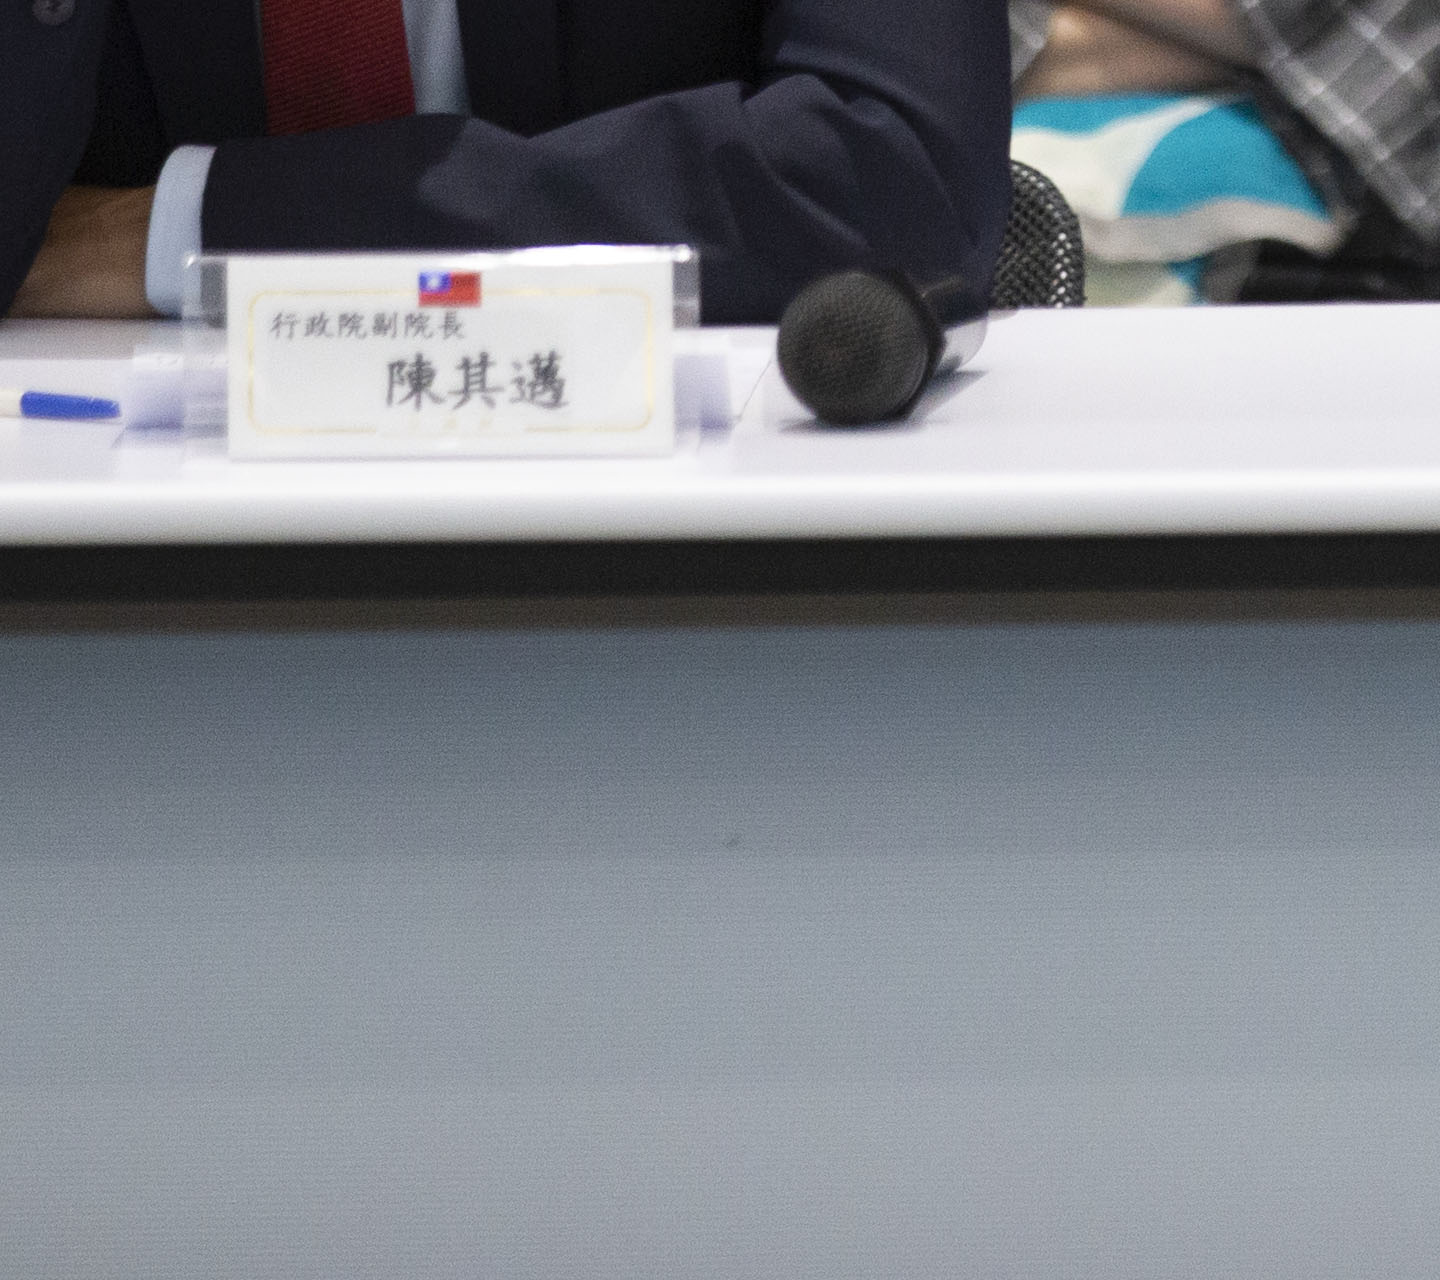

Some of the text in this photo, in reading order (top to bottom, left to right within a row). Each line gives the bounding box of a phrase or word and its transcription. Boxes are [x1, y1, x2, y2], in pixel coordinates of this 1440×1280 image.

[269, 310, 465, 341] 行政院副院長
[386, 350, 569, 412] 陳其邁
